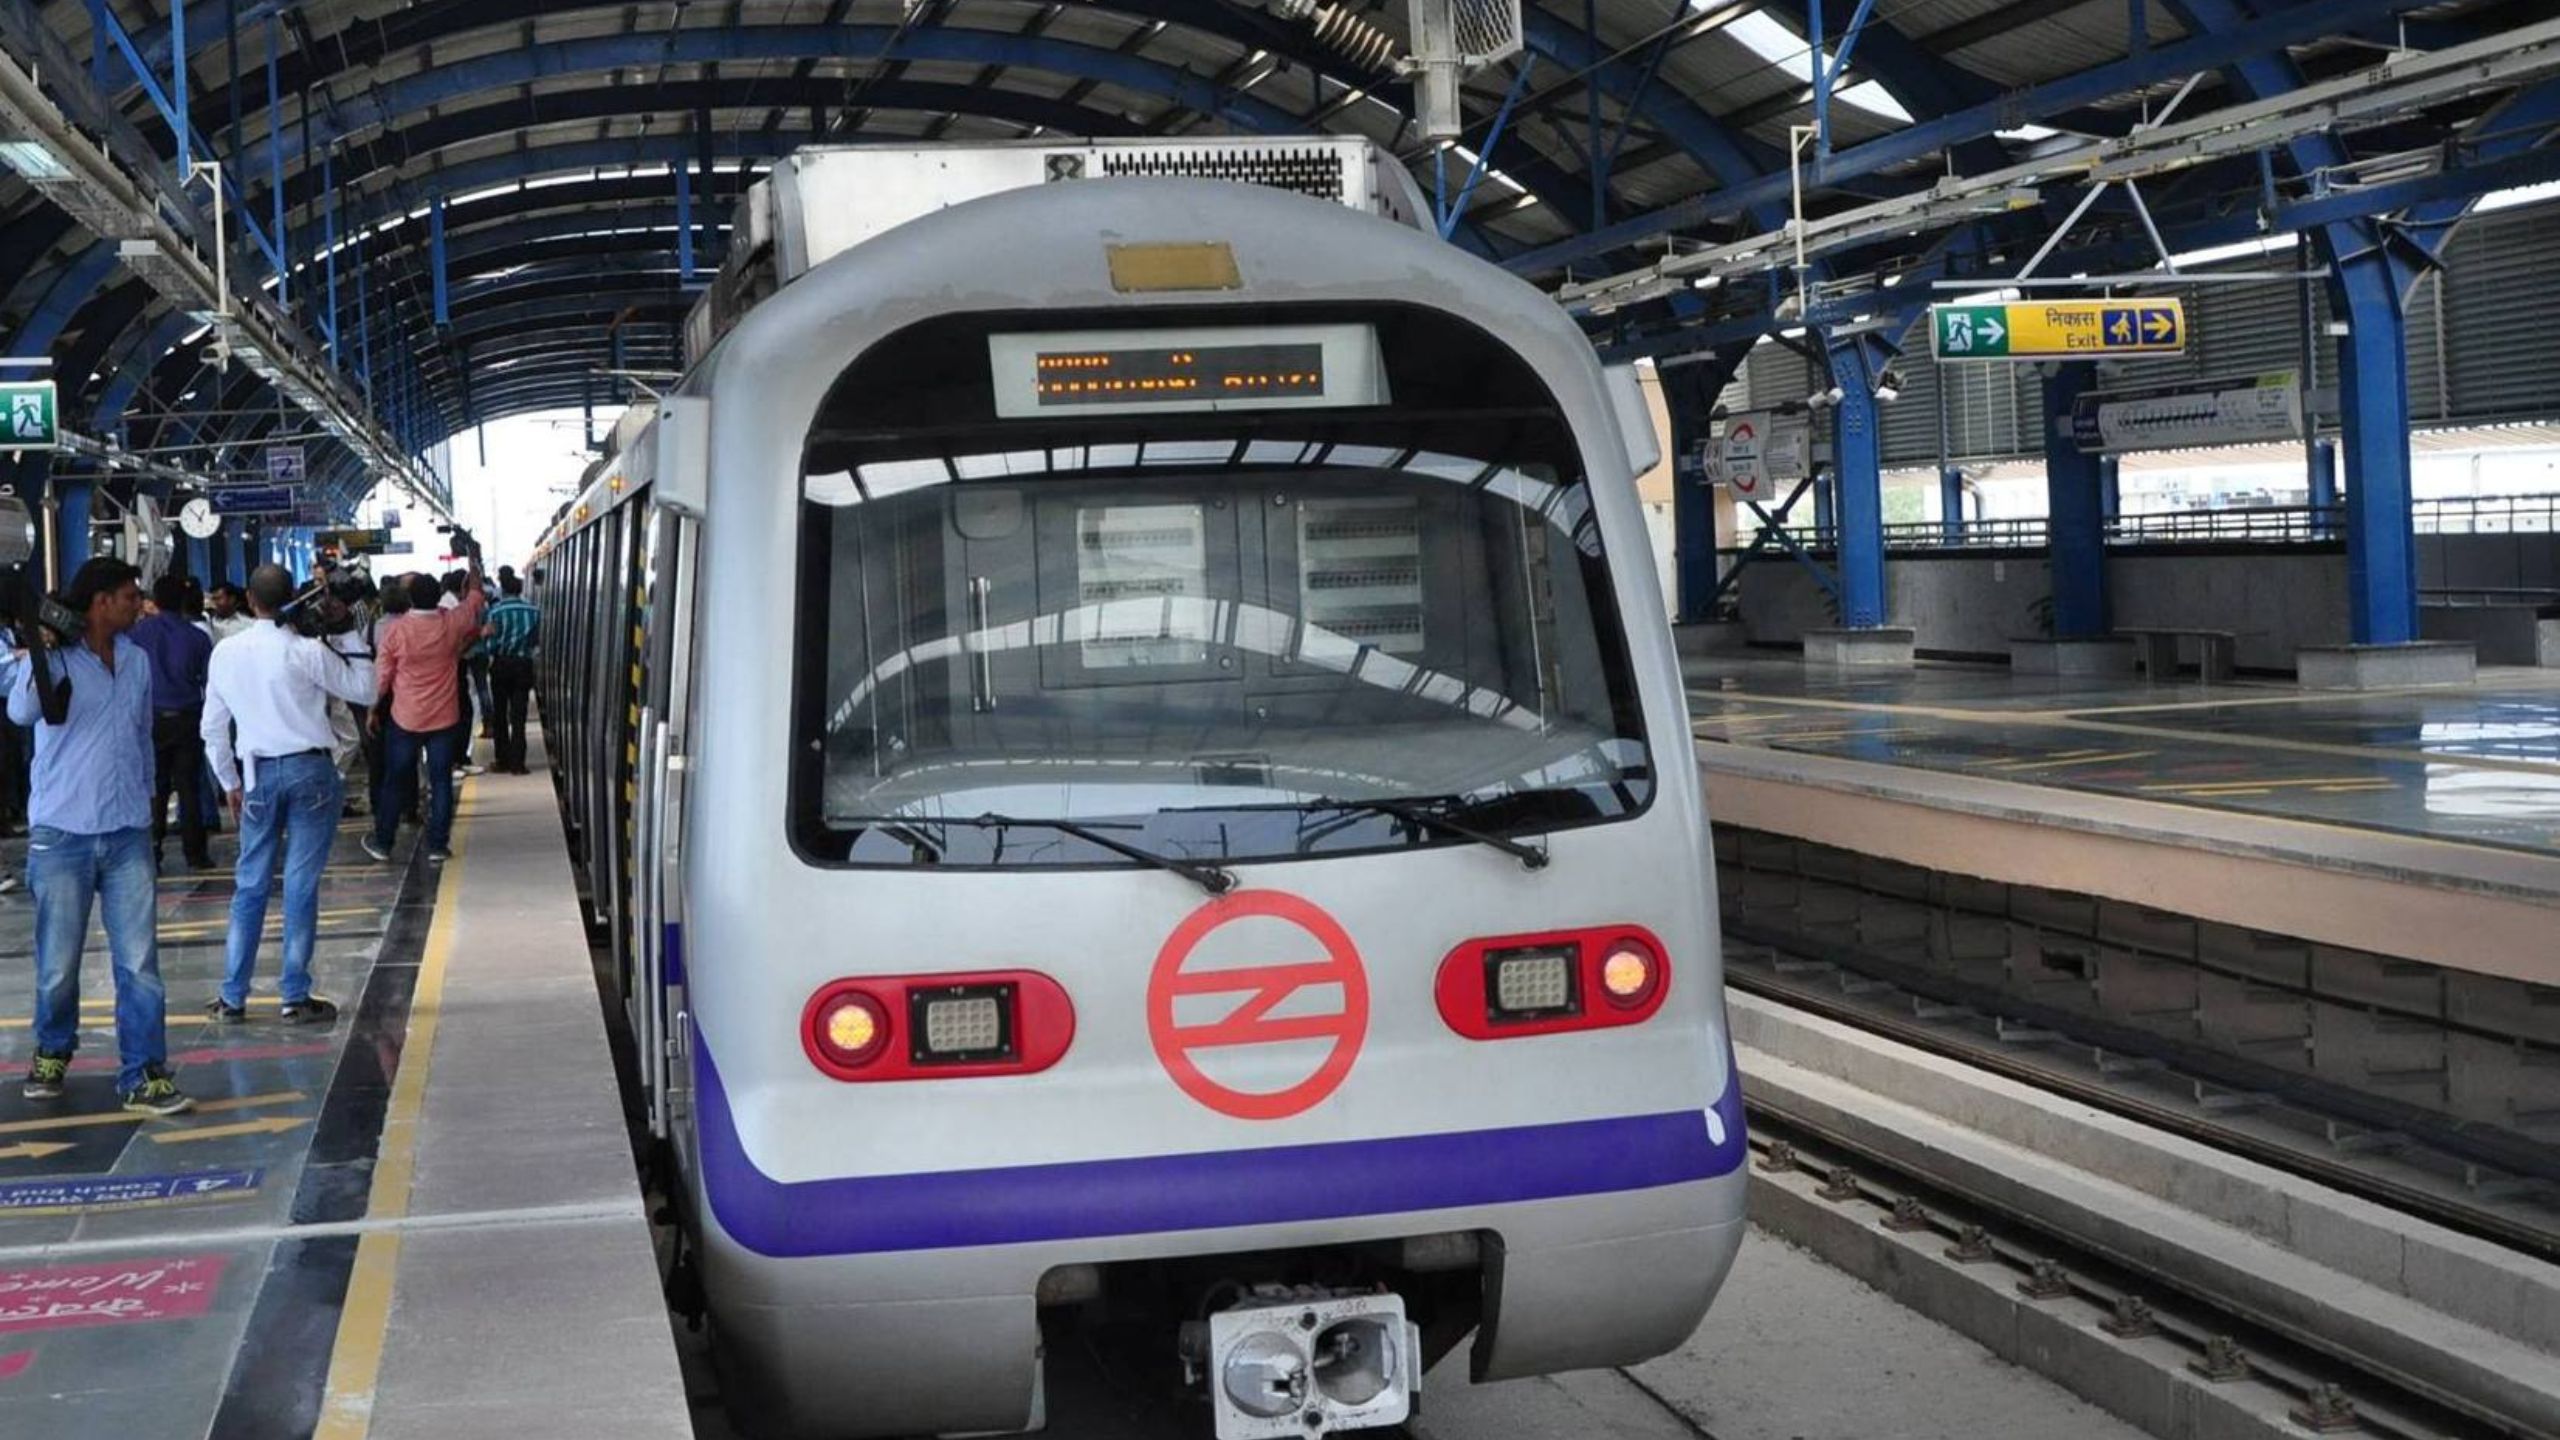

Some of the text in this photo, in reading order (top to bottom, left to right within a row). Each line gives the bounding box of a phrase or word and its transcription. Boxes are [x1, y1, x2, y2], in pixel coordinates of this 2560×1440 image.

[2045, 307, 2096, 327] निकास
[2066, 332, 2097, 348] Exit
[192, 1178, 230, 1192] 4
